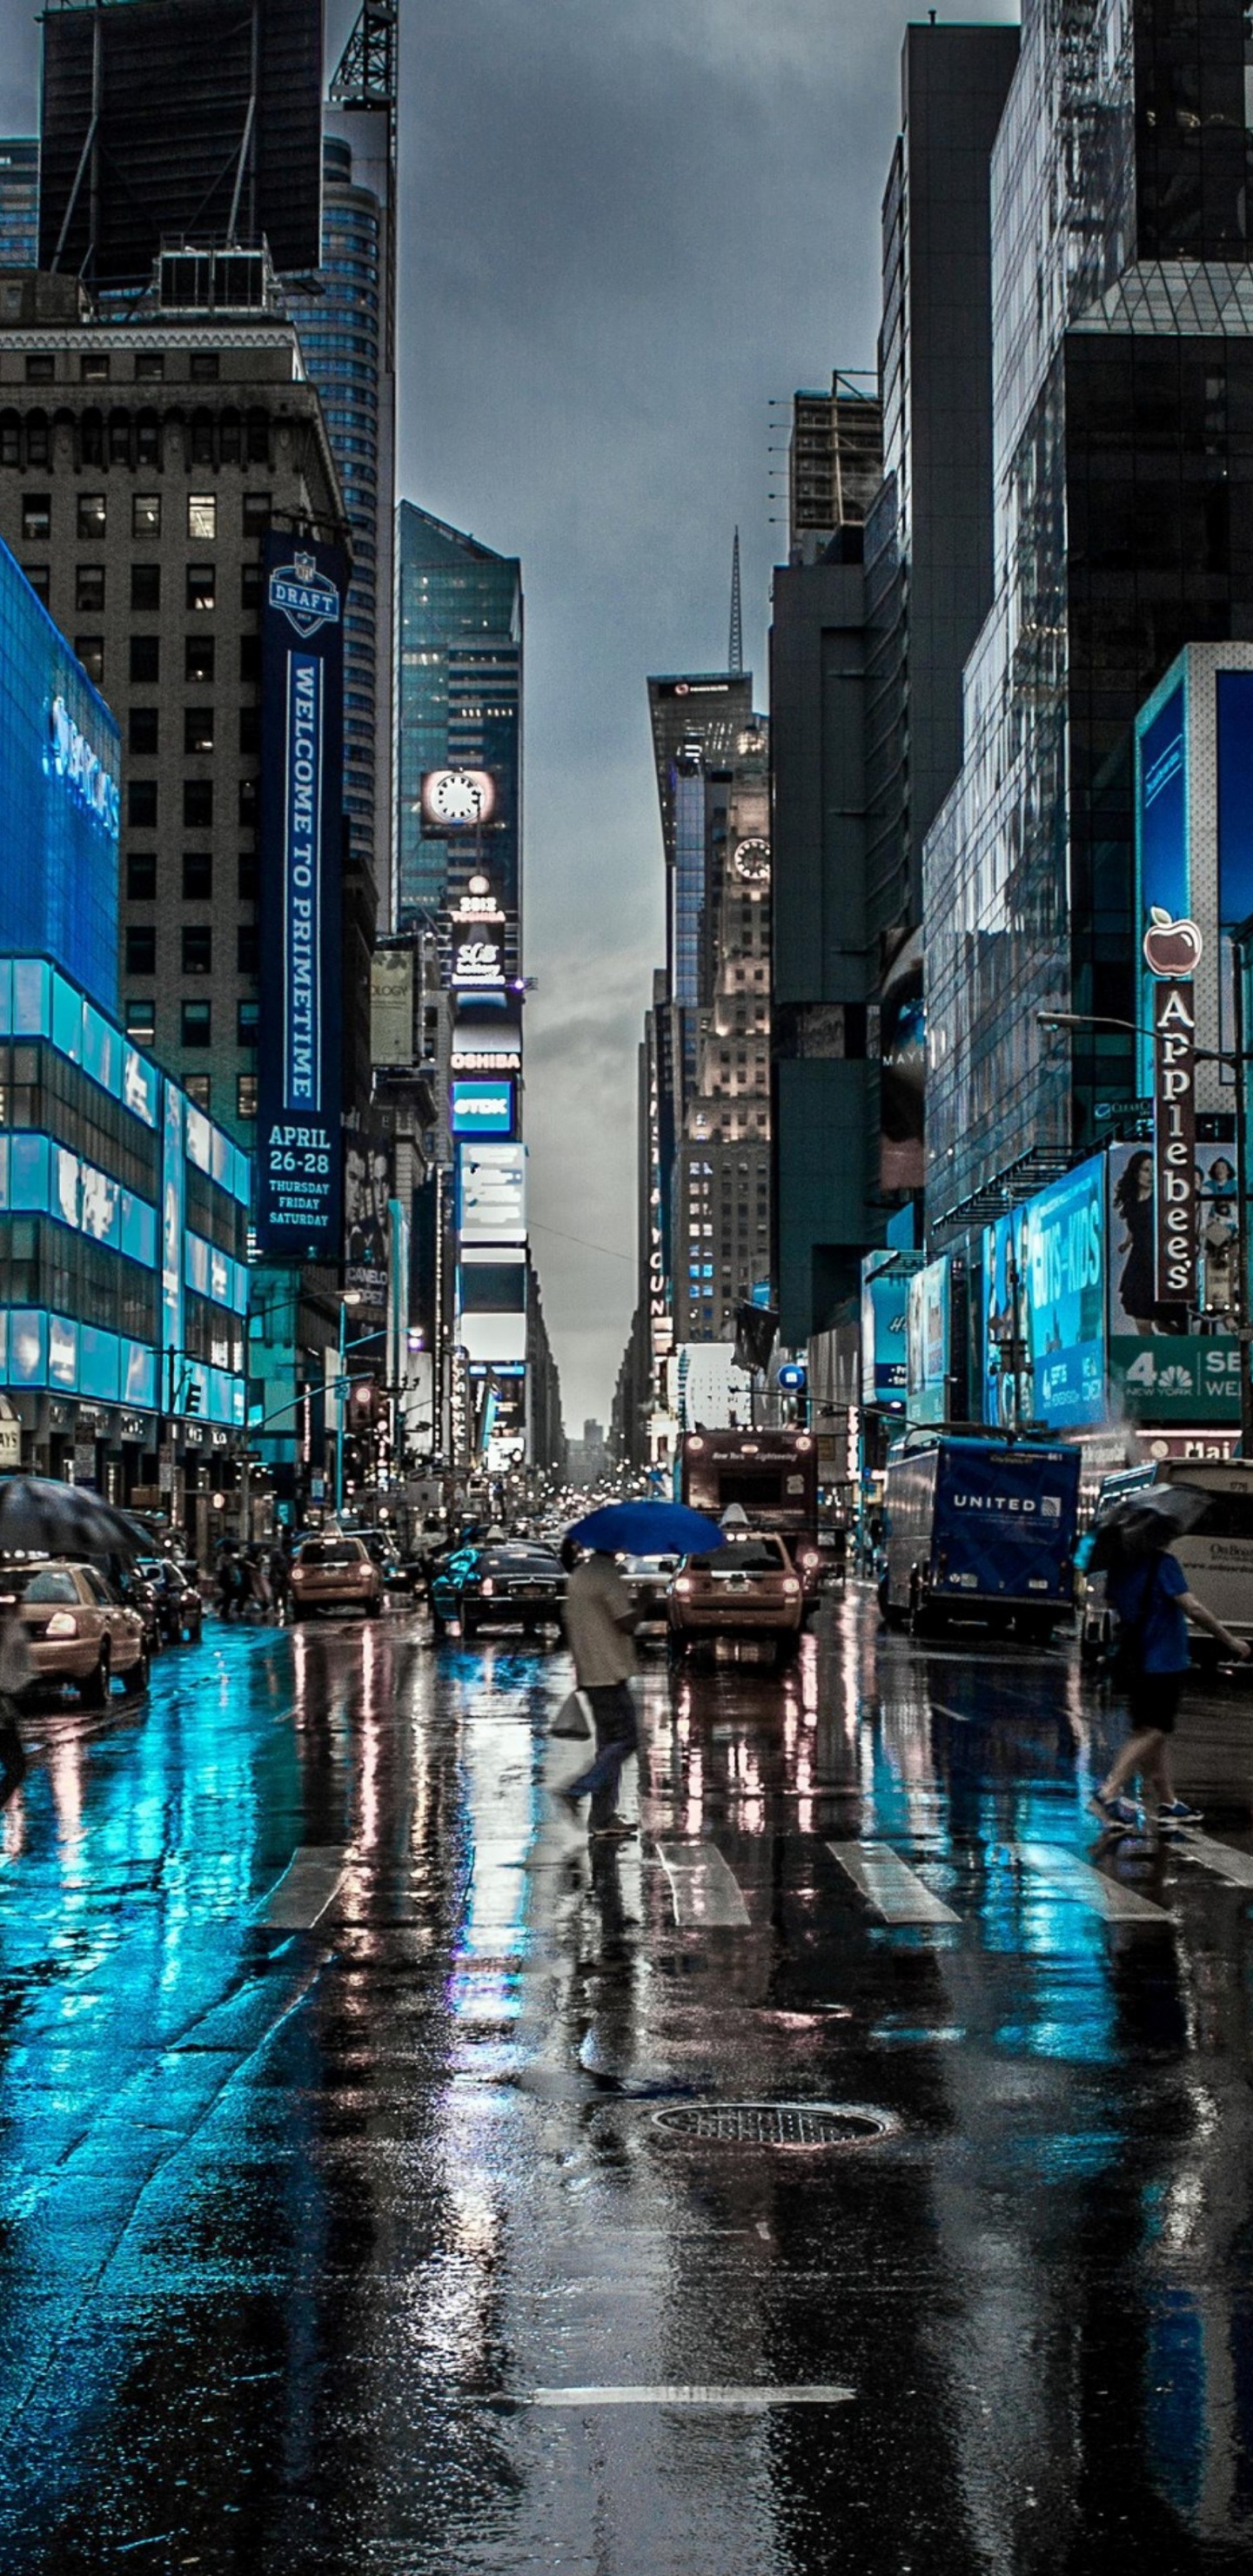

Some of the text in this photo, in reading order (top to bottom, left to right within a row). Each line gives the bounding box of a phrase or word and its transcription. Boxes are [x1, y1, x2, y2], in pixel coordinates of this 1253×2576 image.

[275, 584, 333, 612] DRAFT
[293, 666, 315, 1098] WELCOME TO PRIMETIME
[268, 1124, 331, 1149] APRIL
[1156, 989, 1196, 1290] Applebee's
[270, 1150, 330, 1174] 26-28
[269, 1179, 330, 1195] THURSDAY
[278, 1196, 320, 1210] FRIDAY
[269, 1211, 329, 1226] SATURDAY
[1126, 1352, 1158, 1386] 4
[1127, 1387, 1154, 1396] NEW
[1157, 1387, 1193, 1397] YORK
[954, 1494, 1036, 1512] UNITED
